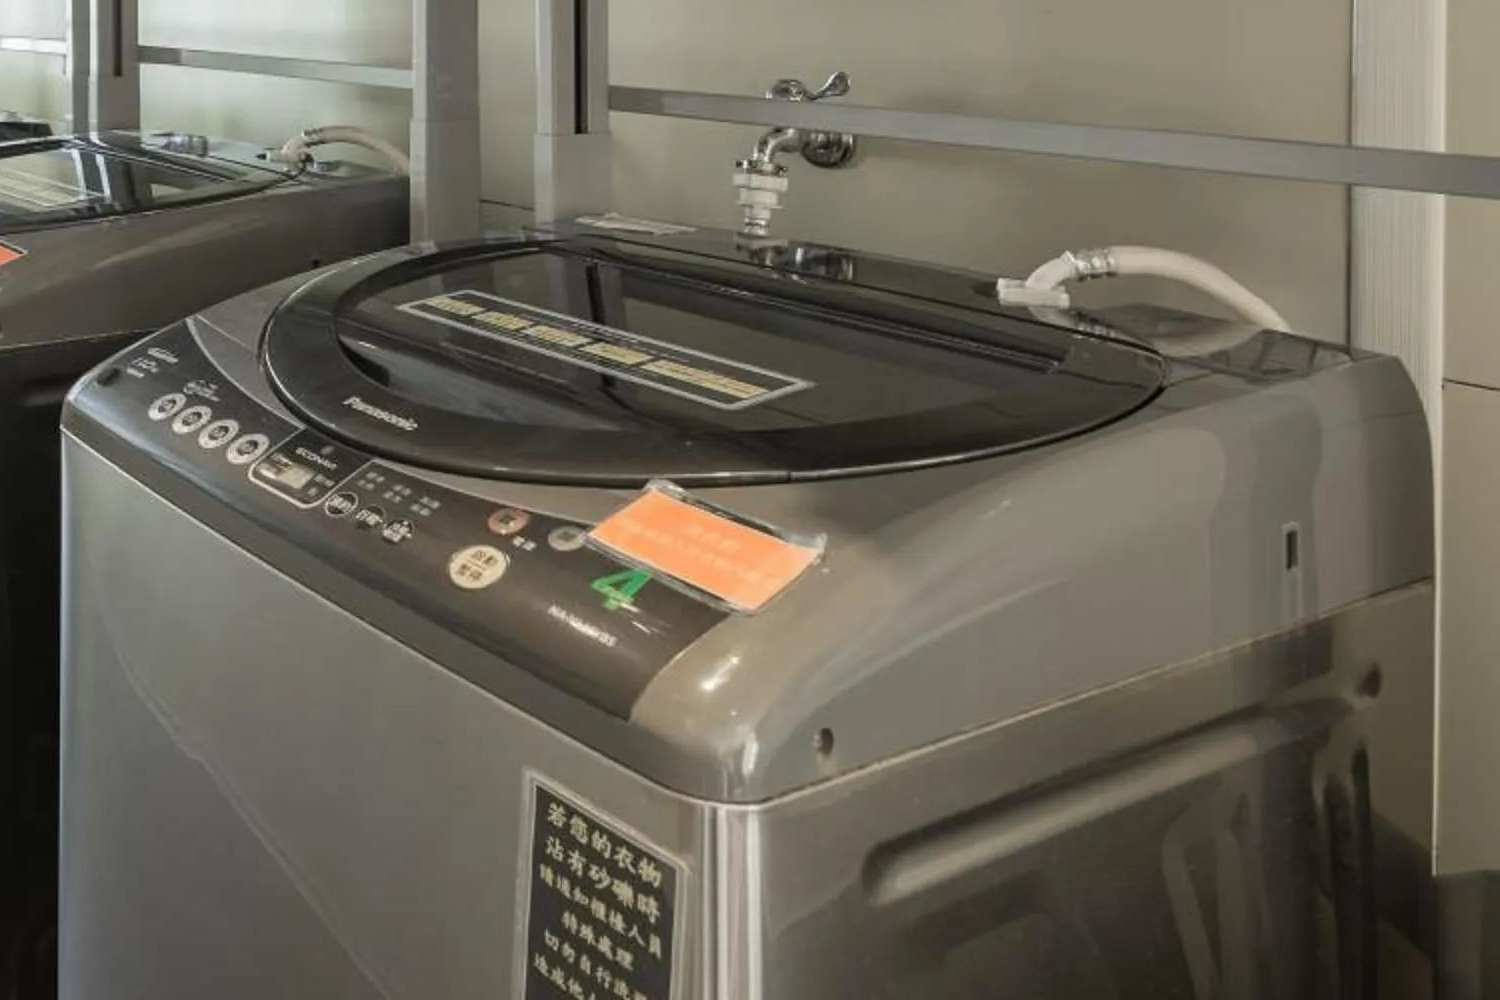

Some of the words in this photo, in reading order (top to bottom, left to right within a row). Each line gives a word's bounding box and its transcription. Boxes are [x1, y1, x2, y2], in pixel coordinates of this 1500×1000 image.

[342, 396, 419, 432] Panasonic
[591, 567, 652, 610] 4
[547, 801, 662, 888] 若您的衣物
